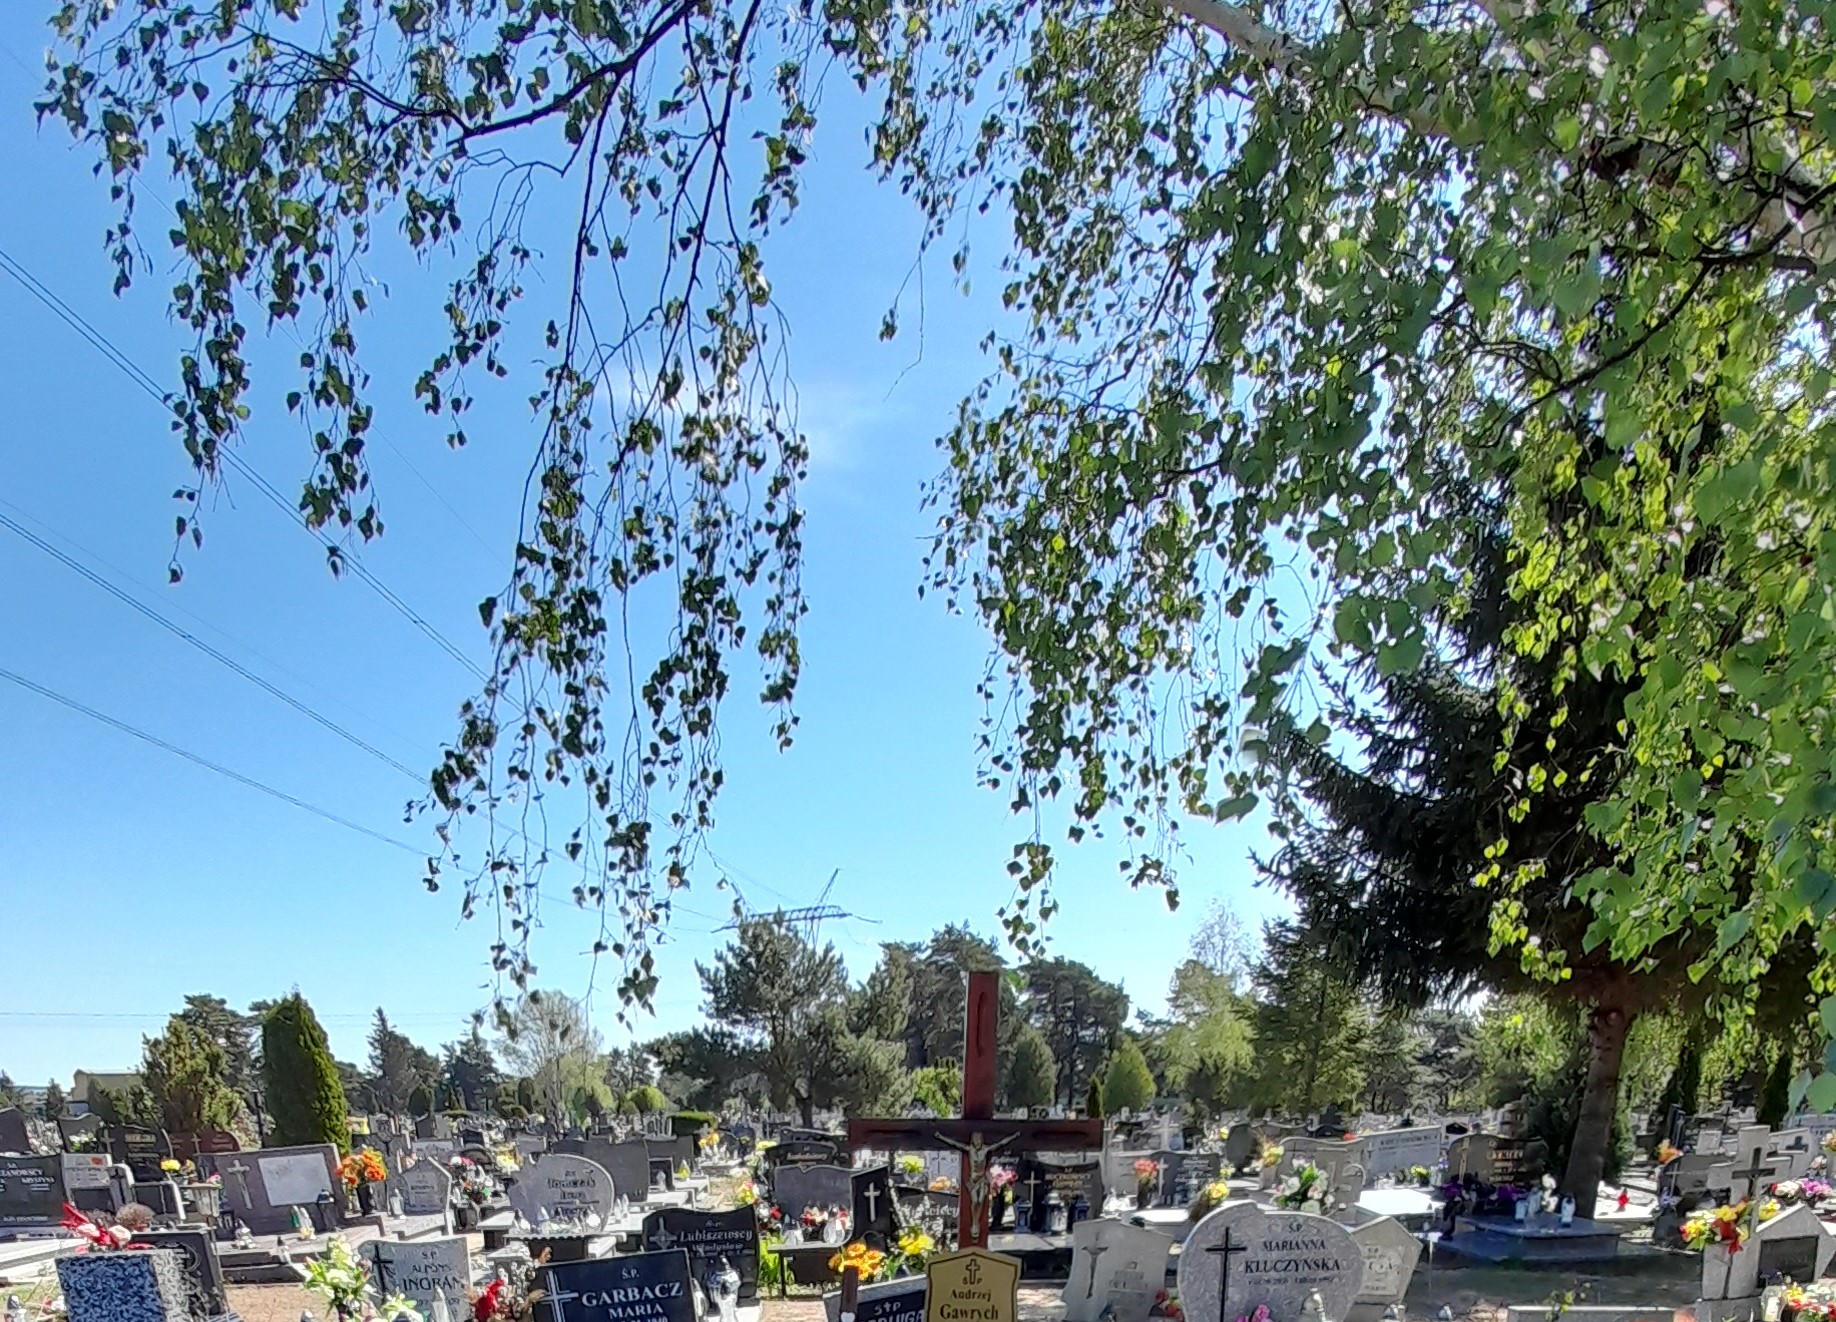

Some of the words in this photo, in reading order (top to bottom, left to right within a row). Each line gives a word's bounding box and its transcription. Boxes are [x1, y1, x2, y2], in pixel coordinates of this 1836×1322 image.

[1263, 1238, 1326, 1252] MARIANNA
[1244, 1256, 1341, 1274] KLUCZYŃSKA
[581, 1281, 684, 1307] GARBACZ
[950, 1289, 992, 1303] Andrzej
[608, 1303, 664, 1320] MARIA
